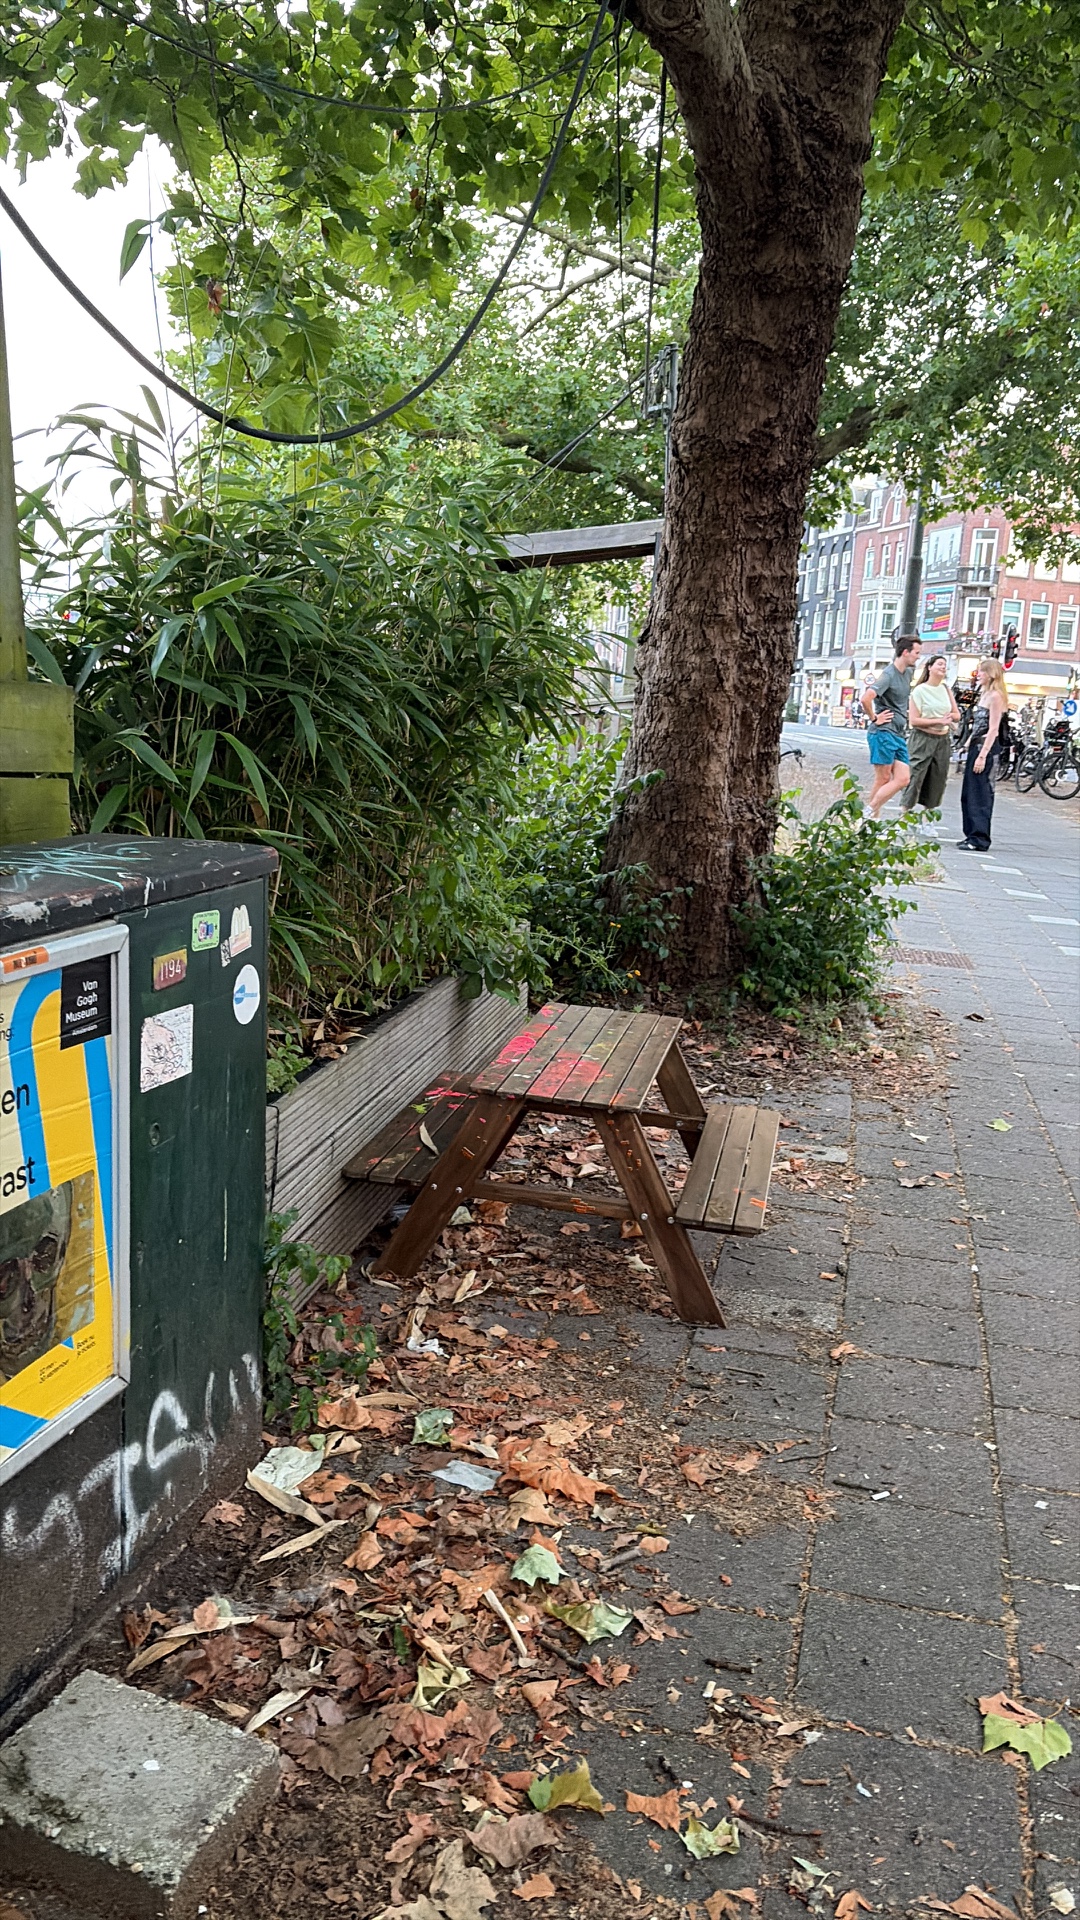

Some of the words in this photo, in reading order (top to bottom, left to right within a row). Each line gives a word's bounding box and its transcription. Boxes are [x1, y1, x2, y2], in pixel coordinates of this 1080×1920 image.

[160, 959, 182, 981] 1194
[82, 980, 98, 992] Van
[76, 992, 98, 1007] Gogh
[65, 1006, 98, 1024] Museum
[0, 1083, 30, 1117] en
[0, 1156, 36, 1198] ast
